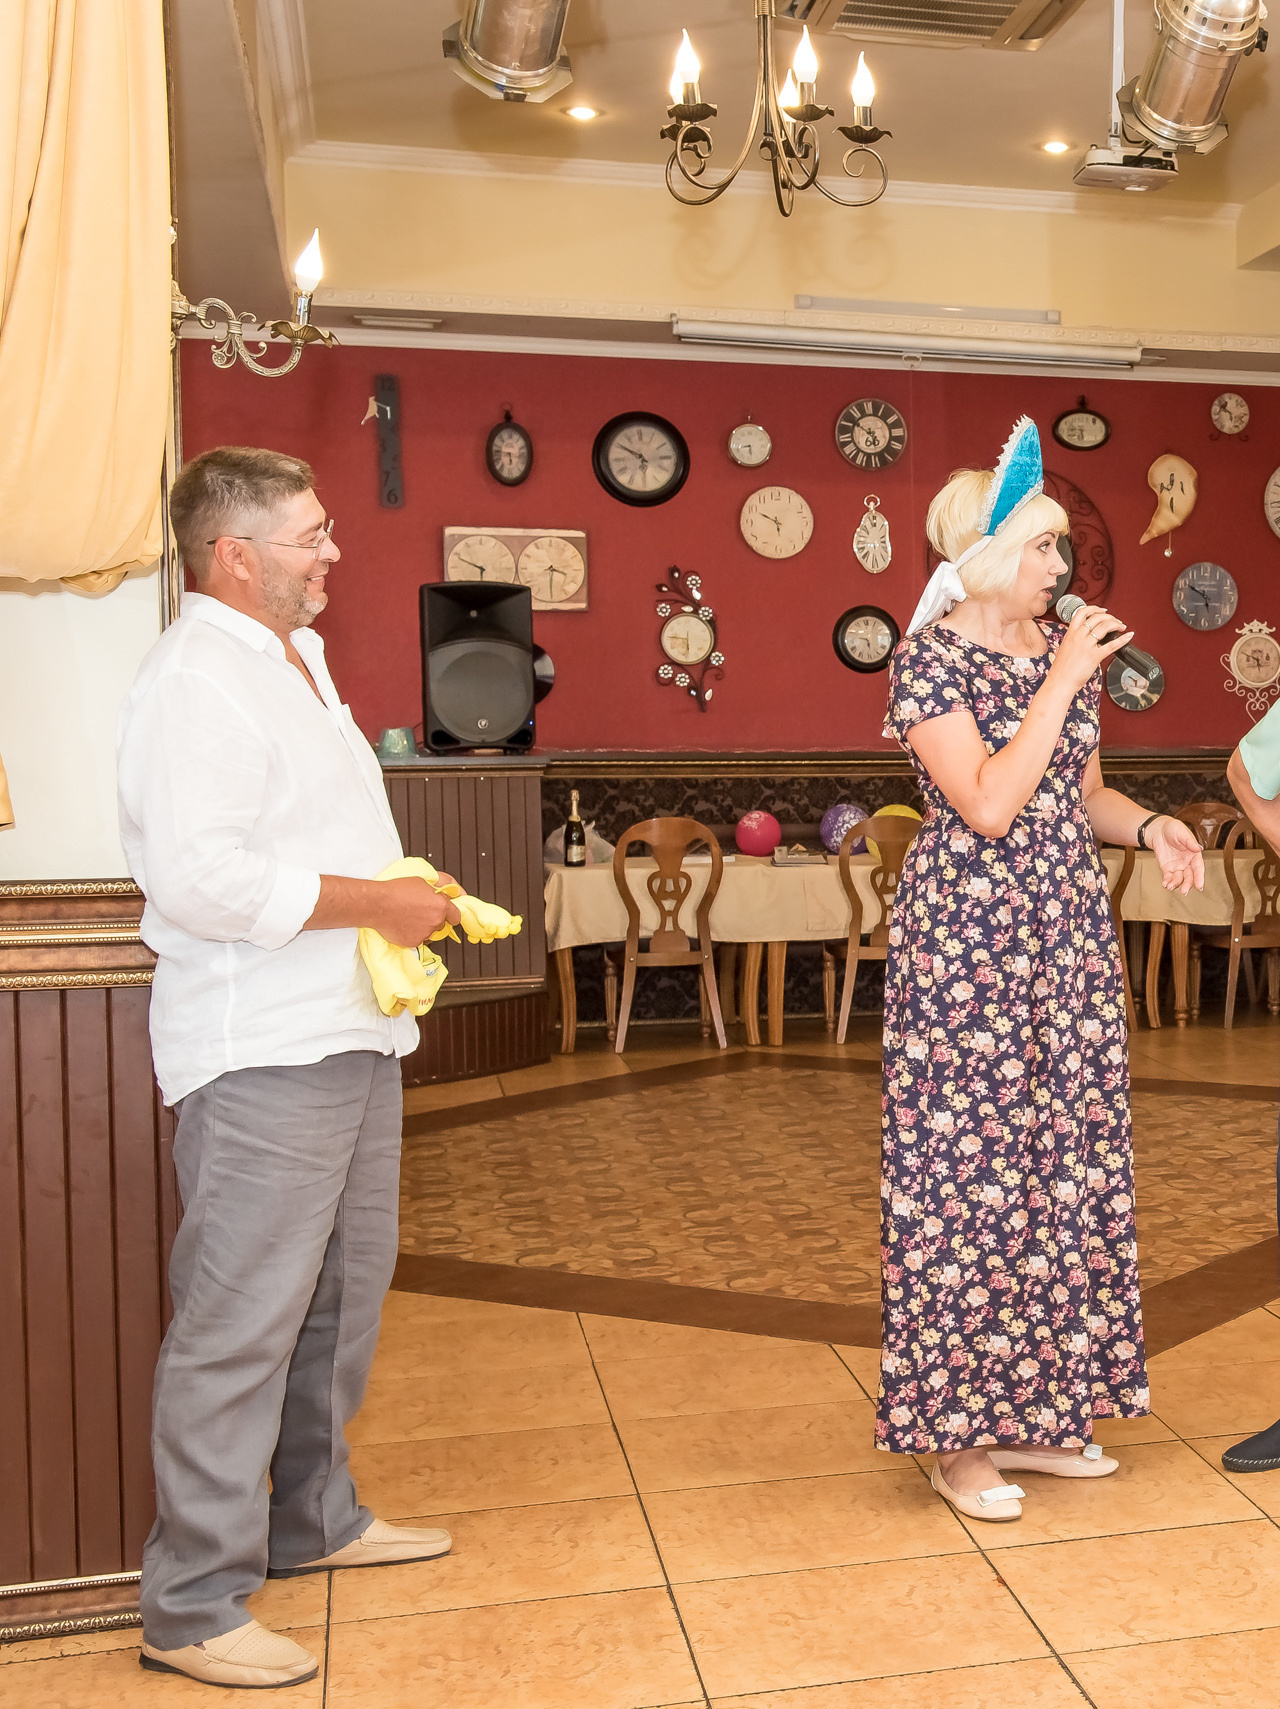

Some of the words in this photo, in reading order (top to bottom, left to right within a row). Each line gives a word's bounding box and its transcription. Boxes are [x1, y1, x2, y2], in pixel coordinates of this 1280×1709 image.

[864, 436, 880, 447] 66
[386, 489, 398, 504] 6
[758, 495, 766, 504] 11
[770, 491, 781, 501] 12
[748, 504, 758, 514] 10
[796, 503, 804, 514] 2
[746, 518, 754, 528] 9
[802, 516, 808, 528] 3
[774, 544, 783, 554] 6
[1189, 570, 1197, 580] 11
[1200, 564, 1211, 576] 12
[1216, 570, 1220, 580] 1
[1179, 578, 1189, 589] 10
[1224, 578, 1230, 590] 2
[1176, 590, 1184, 600] 9
[1228, 591, 1234, 603] 3
[1201, 617, 1209, 628] 6
[1215, 614, 1222, 626] 5
